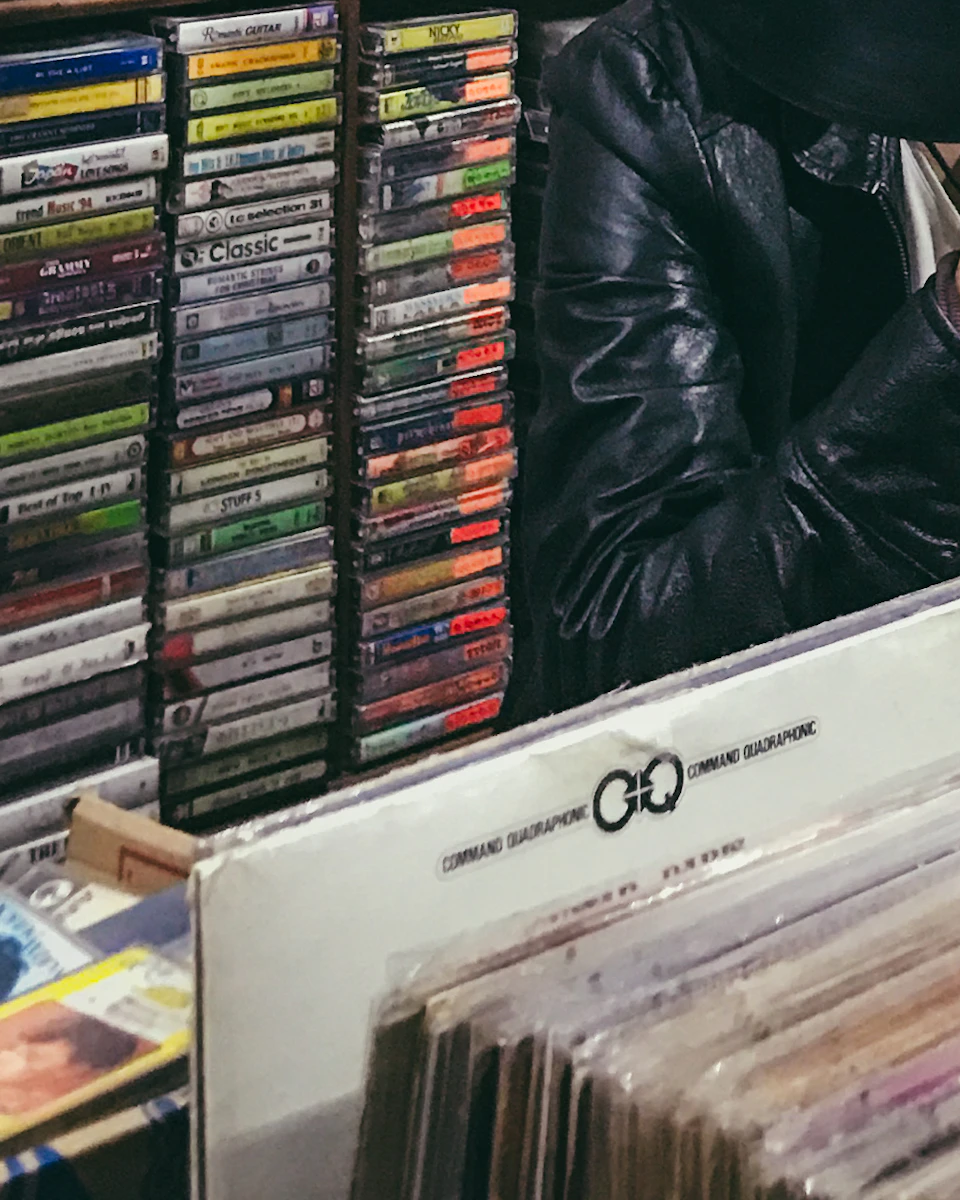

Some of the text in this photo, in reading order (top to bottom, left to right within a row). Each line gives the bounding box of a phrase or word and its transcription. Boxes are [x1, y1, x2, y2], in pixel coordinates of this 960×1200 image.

[245, 21, 282, 36] GUITAR
[429, 23, 461, 39] NICKY
[247, 202, 306, 220] selection
[209, 234, 279, 262] Classic
[687, 719, 818, 780] COMMAND QUADRAPHONIC
[441, 803, 590, 874] COMMAND QUADRAPHONIC
